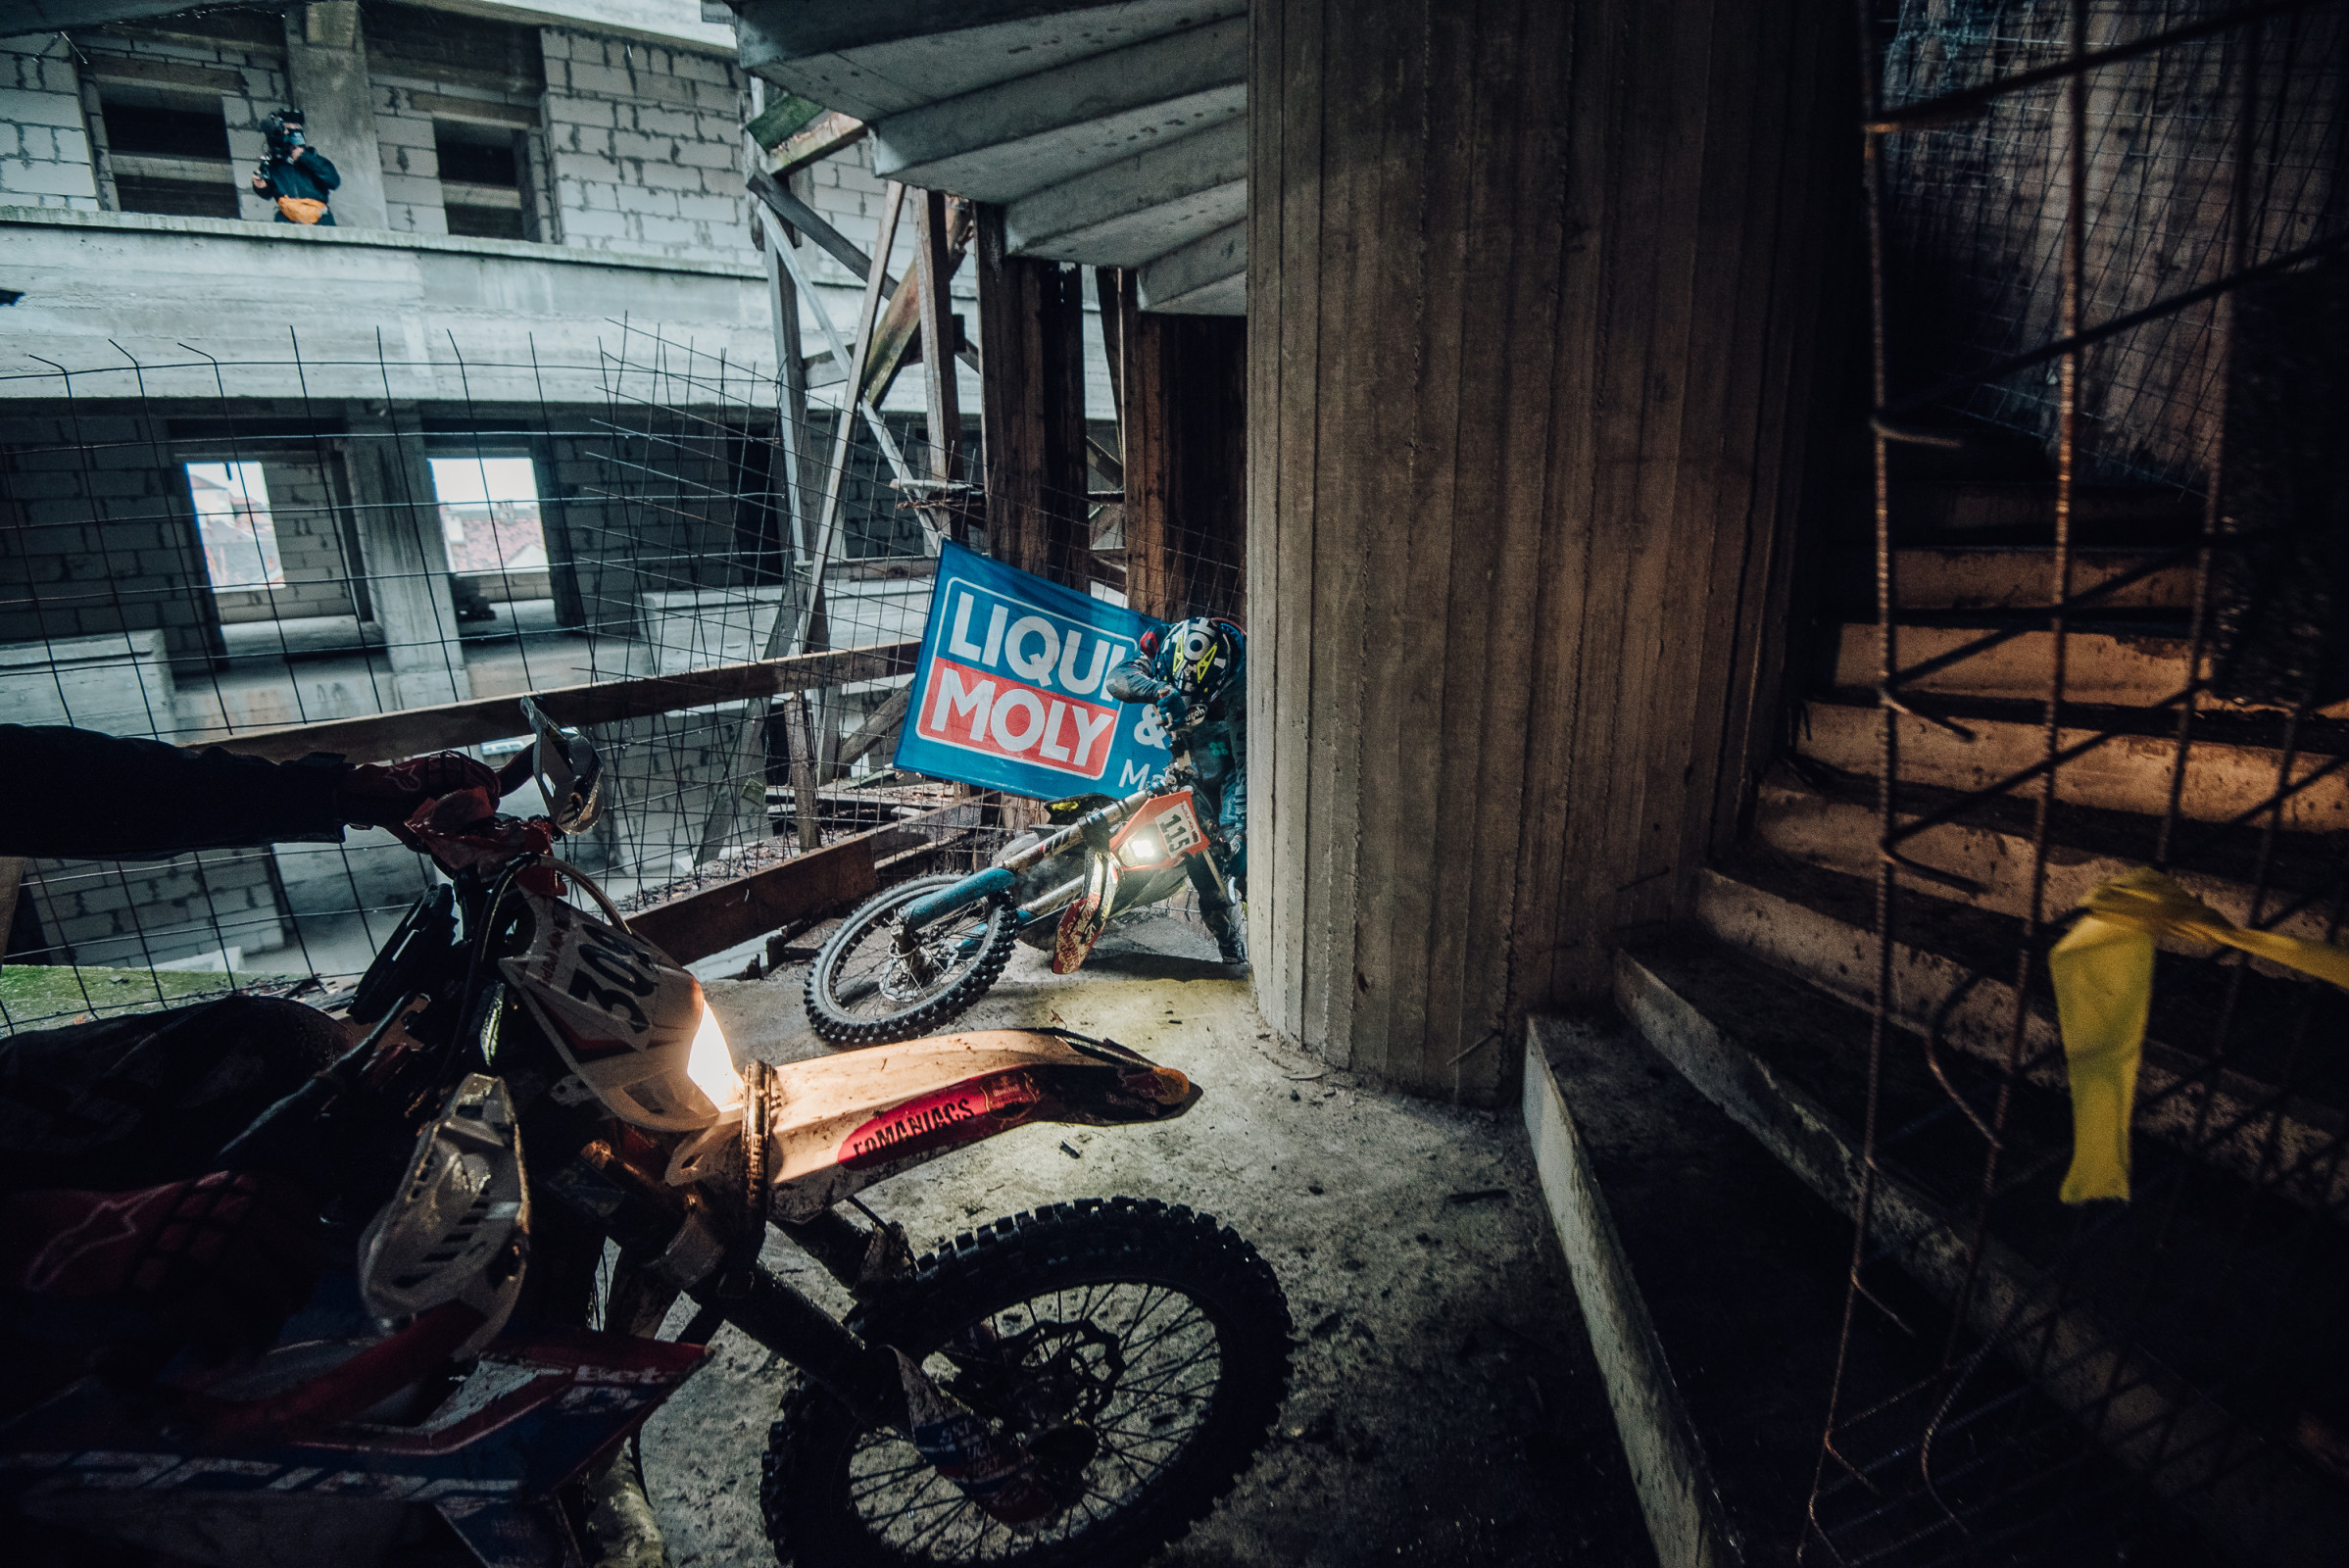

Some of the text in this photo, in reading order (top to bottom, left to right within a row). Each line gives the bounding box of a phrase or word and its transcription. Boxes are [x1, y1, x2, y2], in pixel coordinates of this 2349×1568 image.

[948, 590, 1127, 703] LIQUI
[930, 667, 1114, 767] MOLY
[1159, 813, 1191, 853] 115
